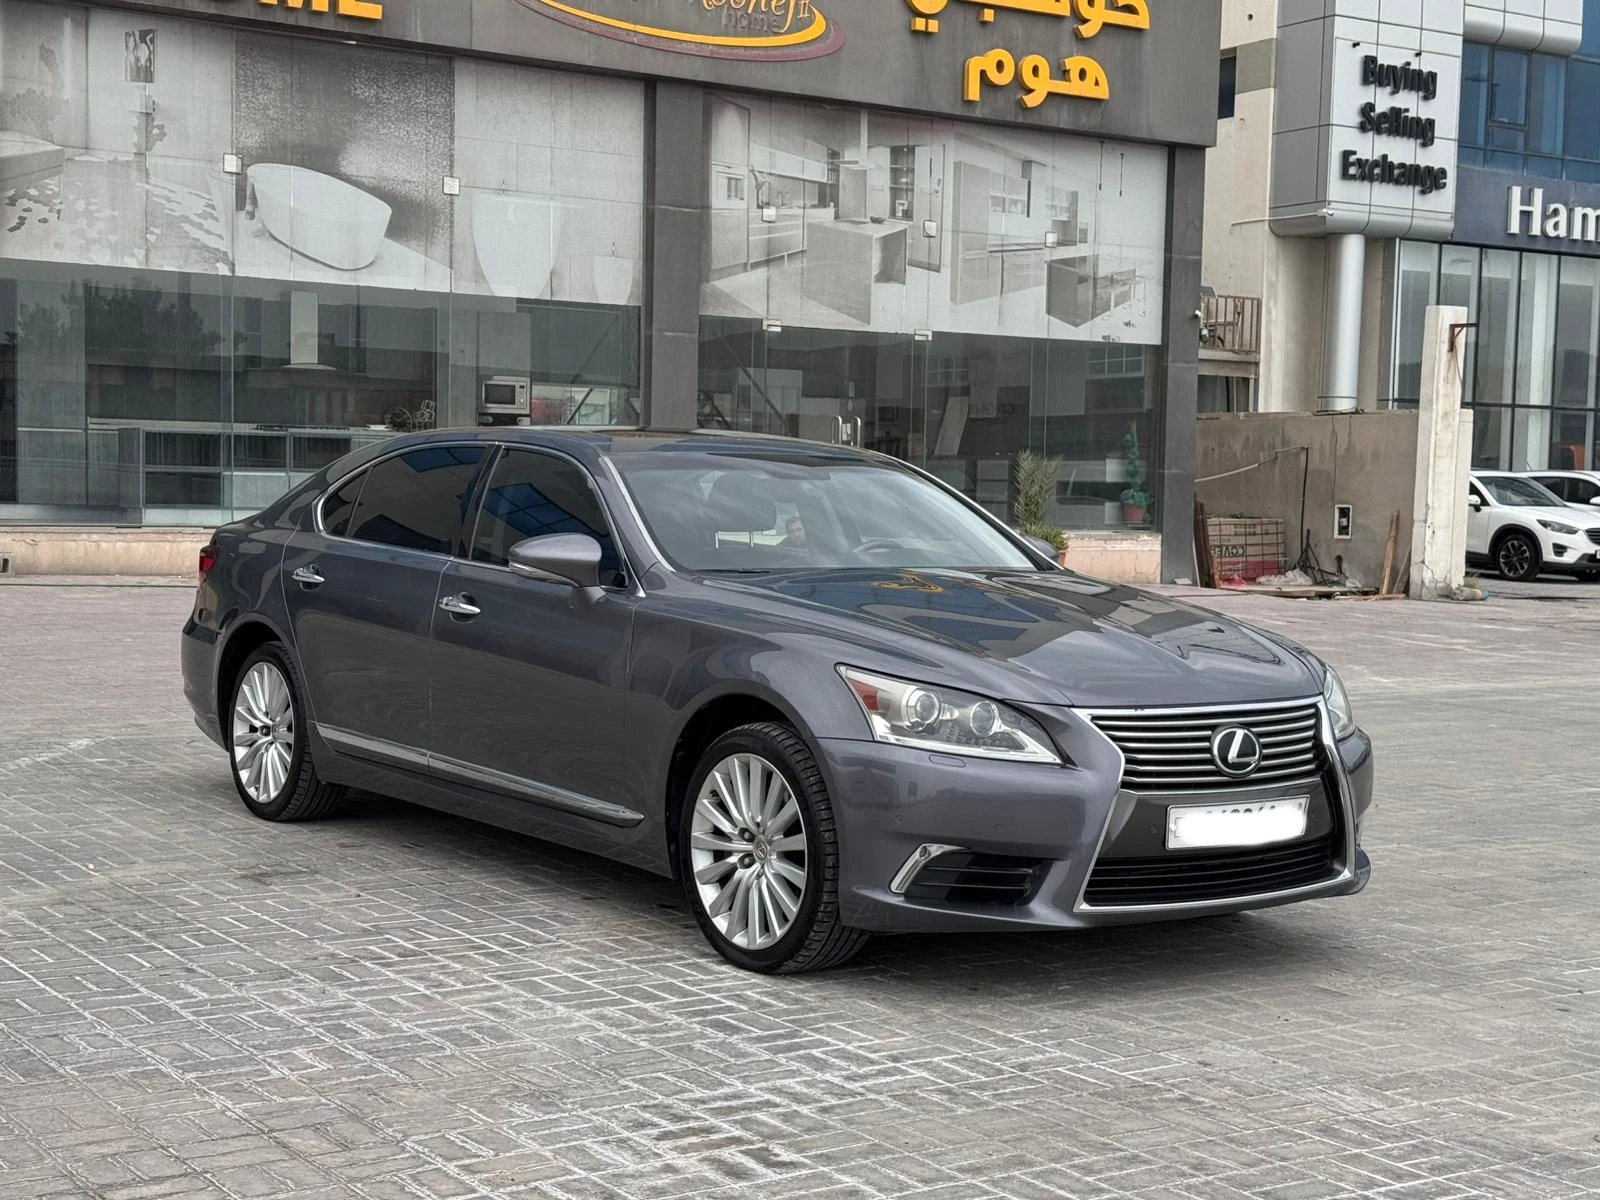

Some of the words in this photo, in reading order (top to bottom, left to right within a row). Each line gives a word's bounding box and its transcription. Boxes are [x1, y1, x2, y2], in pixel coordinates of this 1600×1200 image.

[964, 48, 1110, 108] هوم
[1362, 55, 1438, 100] Buying
[1359, 102, 1436, 147] Selling
[1340, 149, 1447, 194] Exchange
